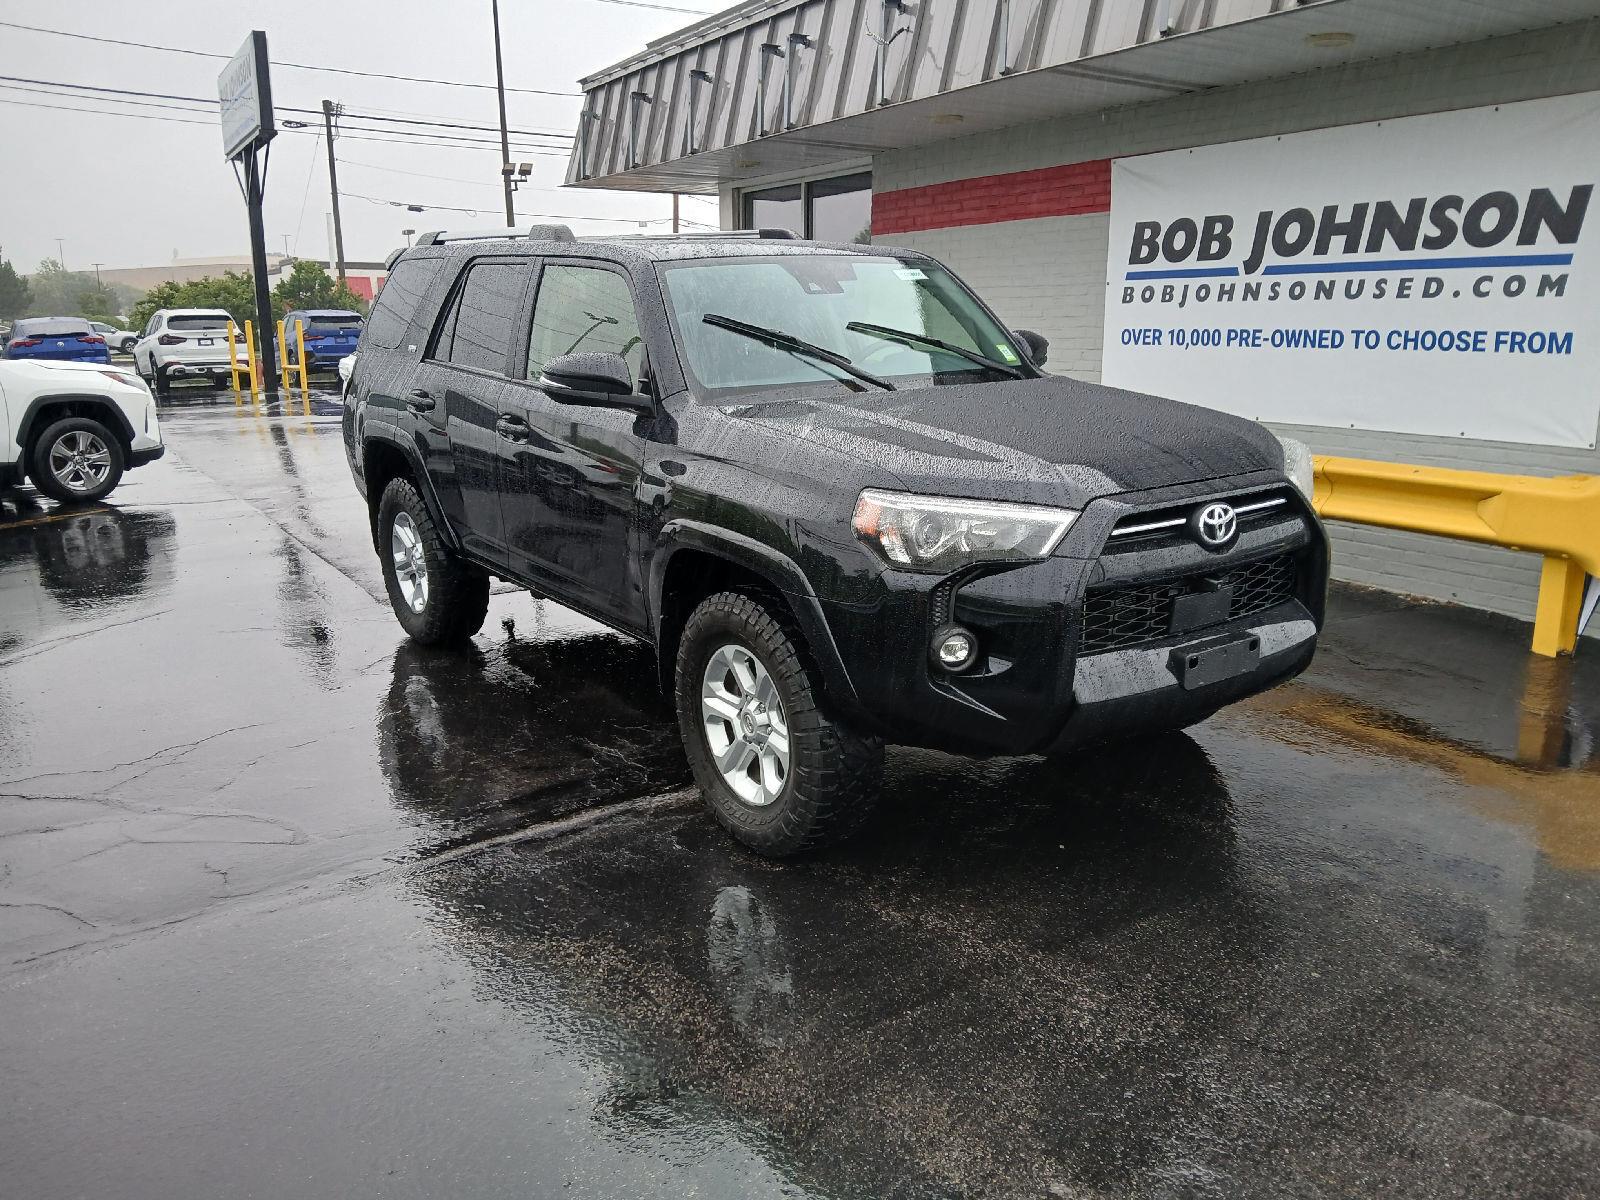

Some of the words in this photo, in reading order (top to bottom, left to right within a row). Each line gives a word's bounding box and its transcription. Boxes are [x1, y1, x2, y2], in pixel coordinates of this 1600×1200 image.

[1128, 214, 1234, 265] BOB
[1242, 184, 1594, 274] JOHNSON
[1121, 273, 1569, 308] BOBJOHNSONUSED.COM
[1120, 328, 1163, 346] OVER
[1168, 328, 1222, 350] 10,000
[1226, 329, 1345, 349] PRE-OWNED
[1350, 329, 1381, 350] TO
[1386, 329, 1488, 352] CHOOSE
[1494, 331, 1574, 355] FROM
